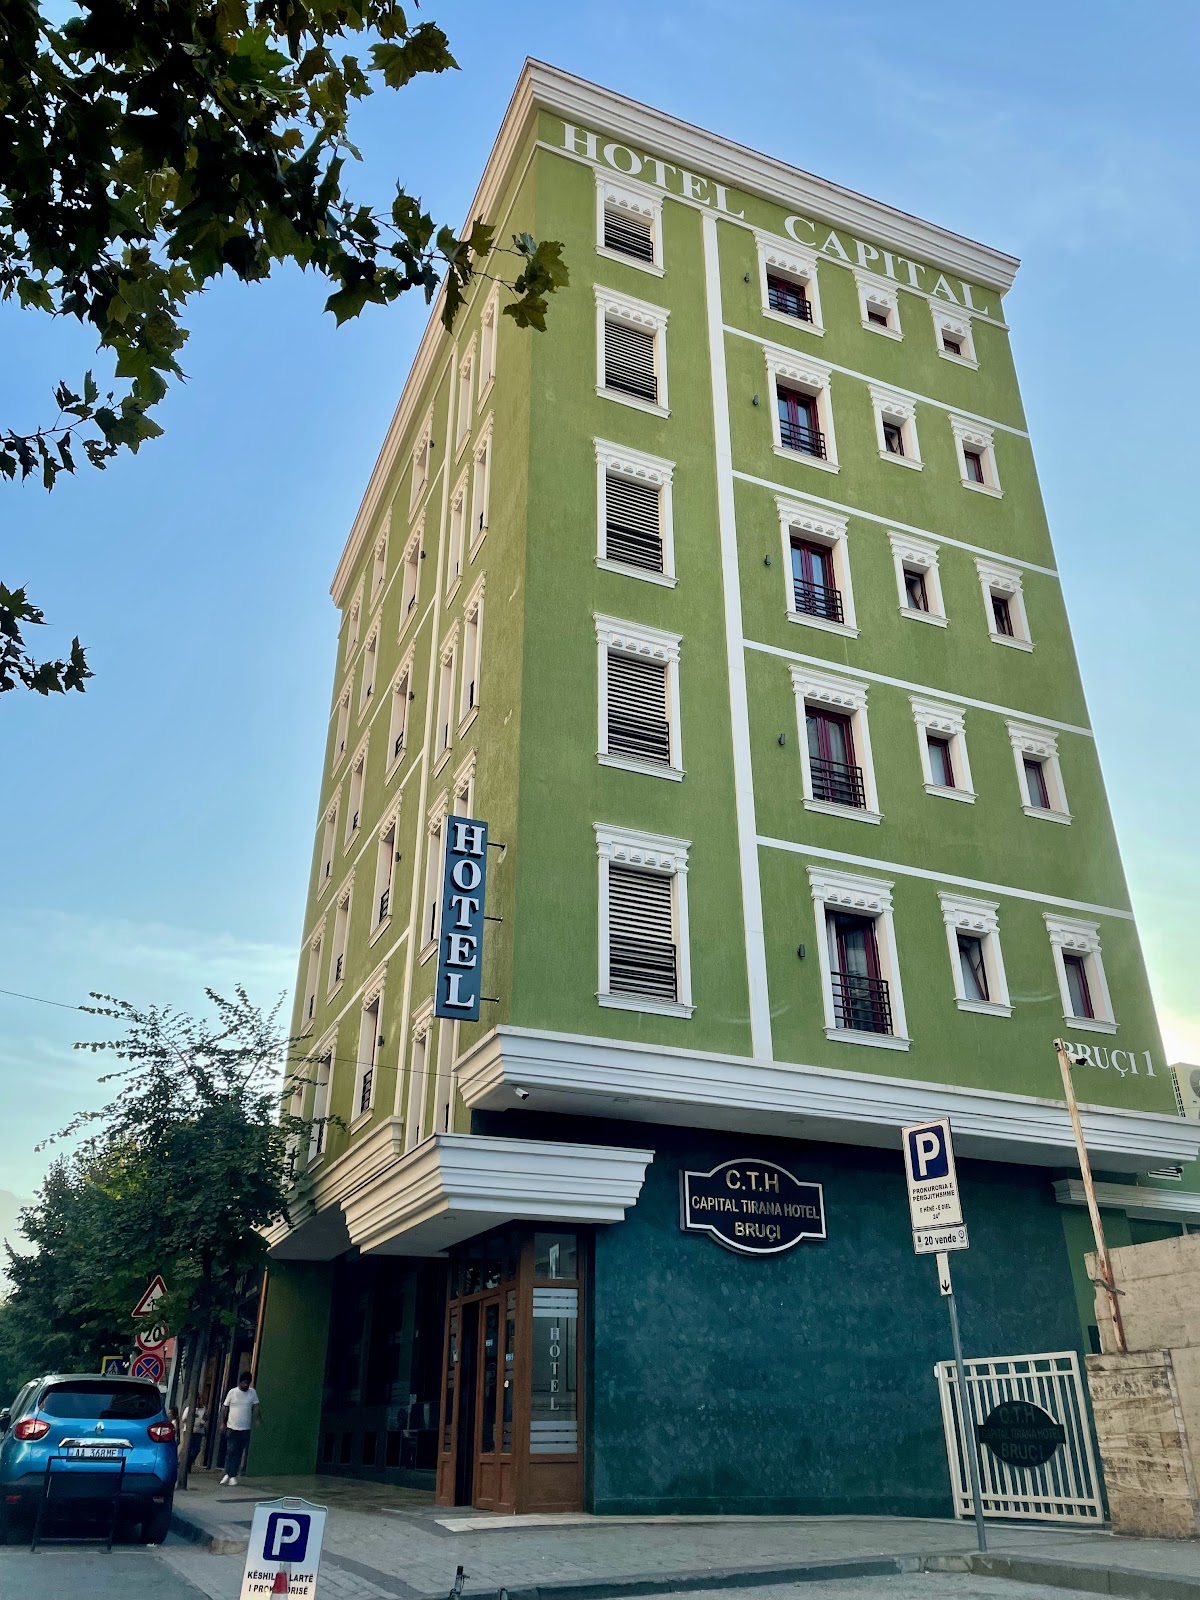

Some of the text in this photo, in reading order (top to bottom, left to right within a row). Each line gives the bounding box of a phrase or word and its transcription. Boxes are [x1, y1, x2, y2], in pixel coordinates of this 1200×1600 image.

[561, 121, 989, 316] HOTEL CAPITAL
[445, 822, 486, 1008] HOTEL
[915, 1131, 941, 1177] P
[725, 1169, 780, 1193] C.T.H
[691, 1195, 820, 1220] CAPITAL TIRANA HOTEL
[734, 1221, 781, 1242] BRUÇI
[924, 1233, 957, 1246] 20 vende
[143, 1326, 161, 1343] 20
[549, 1327, 560, 1411] HOTEL
[271, 1518, 300, 1556] P
[247, 1571, 314, 1583] KËSHIL LARTË
